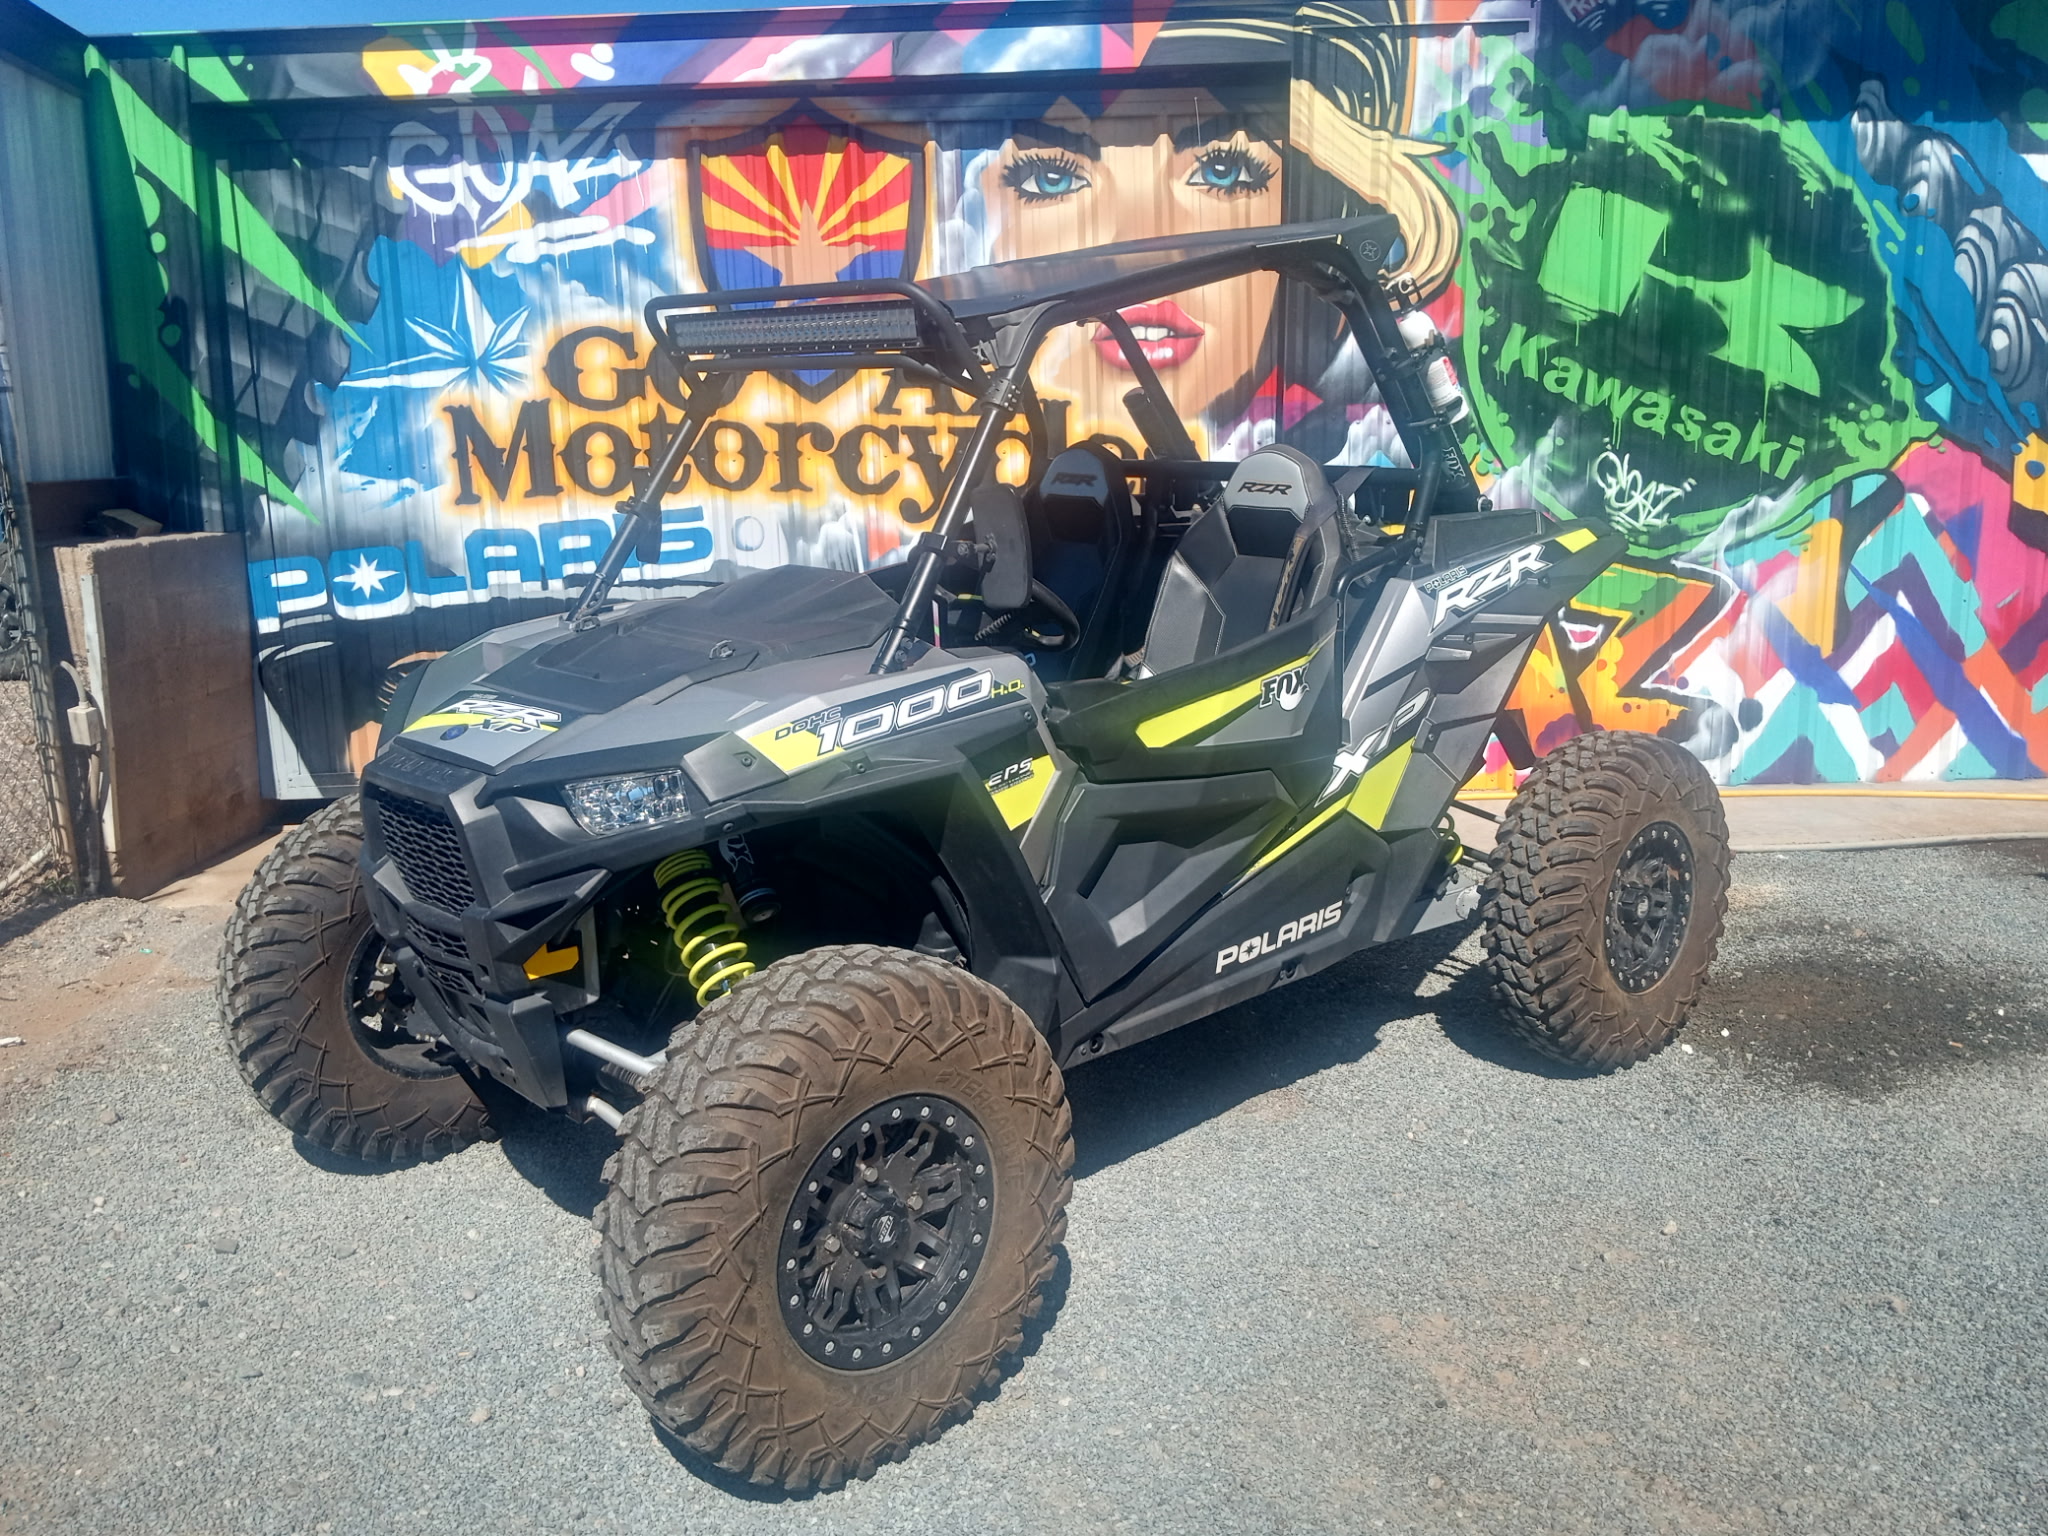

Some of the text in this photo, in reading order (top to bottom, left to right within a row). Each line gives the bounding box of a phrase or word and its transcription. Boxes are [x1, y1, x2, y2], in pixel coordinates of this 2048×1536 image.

[1493, 322, 1807, 480] Kawasaki
[1050, 471, 1098, 488] RZR
[1238, 481, 1293, 496] RZR
[1424, 565, 1468, 594] POLARIS
[1427, 542, 1554, 637] RZR
[1259, 663, 1310, 710] FOX
[435, 699, 562, 729] RZR
[472, 718, 533, 735] XP
[774, 667, 1026, 757] DOHC 1000 H.O.
[1313, 687, 1432, 808] XP
[988, 756, 1034, 787] EPS
[1215, 900, 1343, 975] POLARIS
